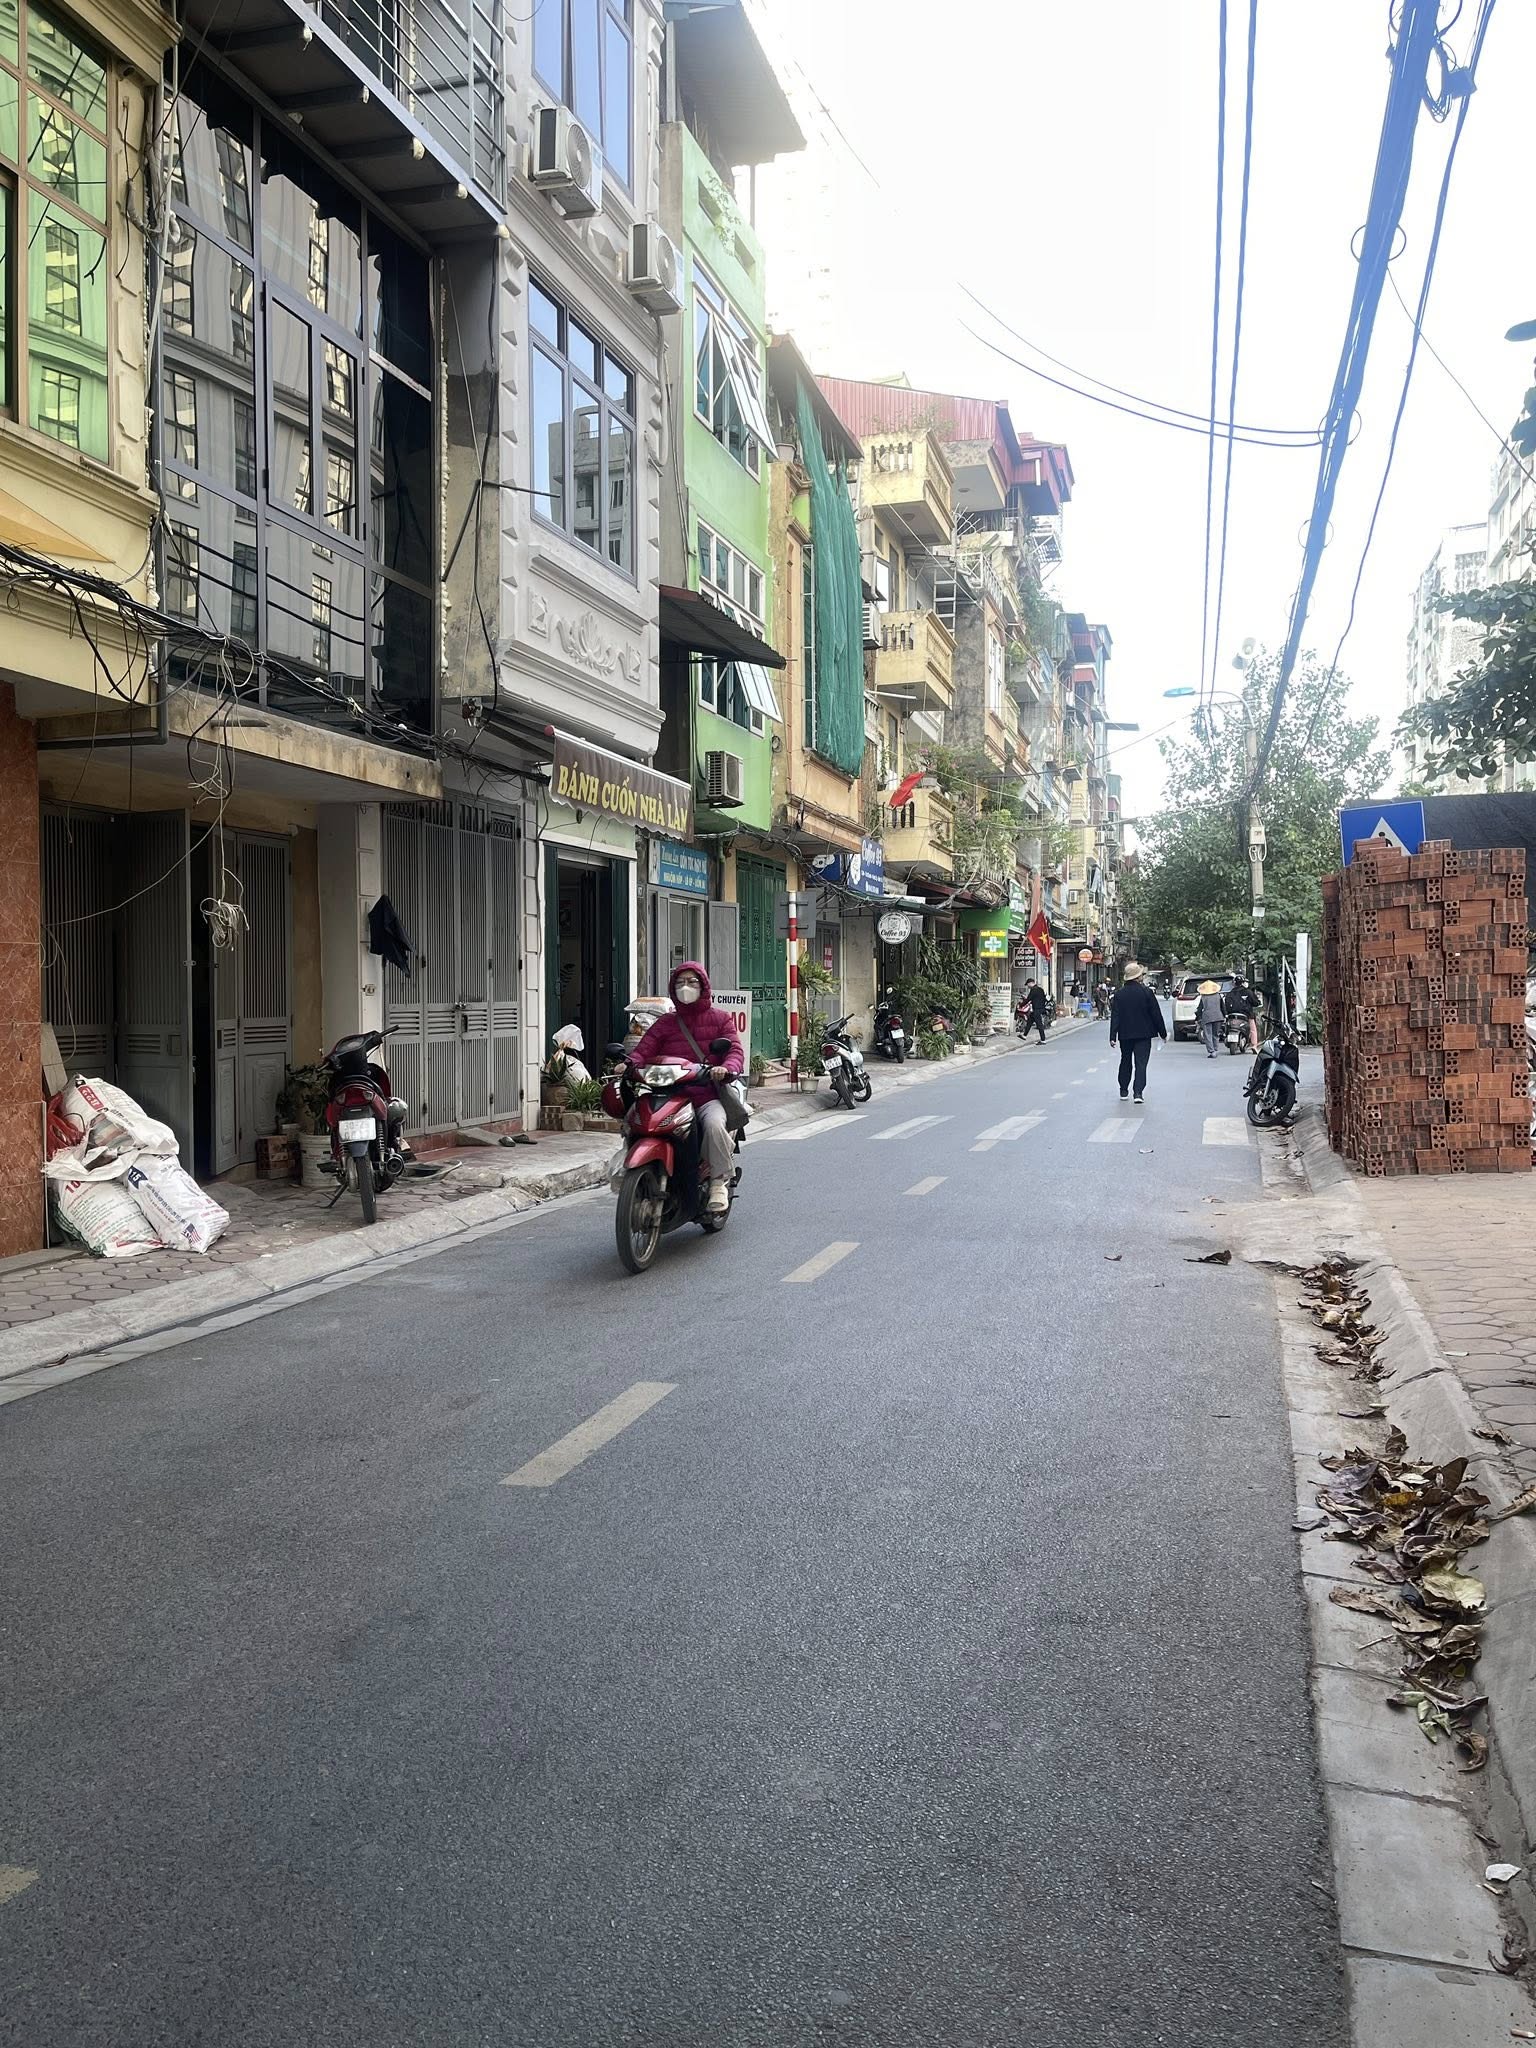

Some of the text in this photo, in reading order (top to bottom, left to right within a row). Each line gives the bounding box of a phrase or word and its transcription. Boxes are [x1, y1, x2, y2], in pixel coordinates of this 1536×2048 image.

[557, 761, 599, 806] BÁNH
[601, 776, 638, 818] CUỐN
[639, 793, 666, 827] NHÀ
[880, 929, 898, 937] Coffee
[717, 994, 746, 1004] CHUYÊN
